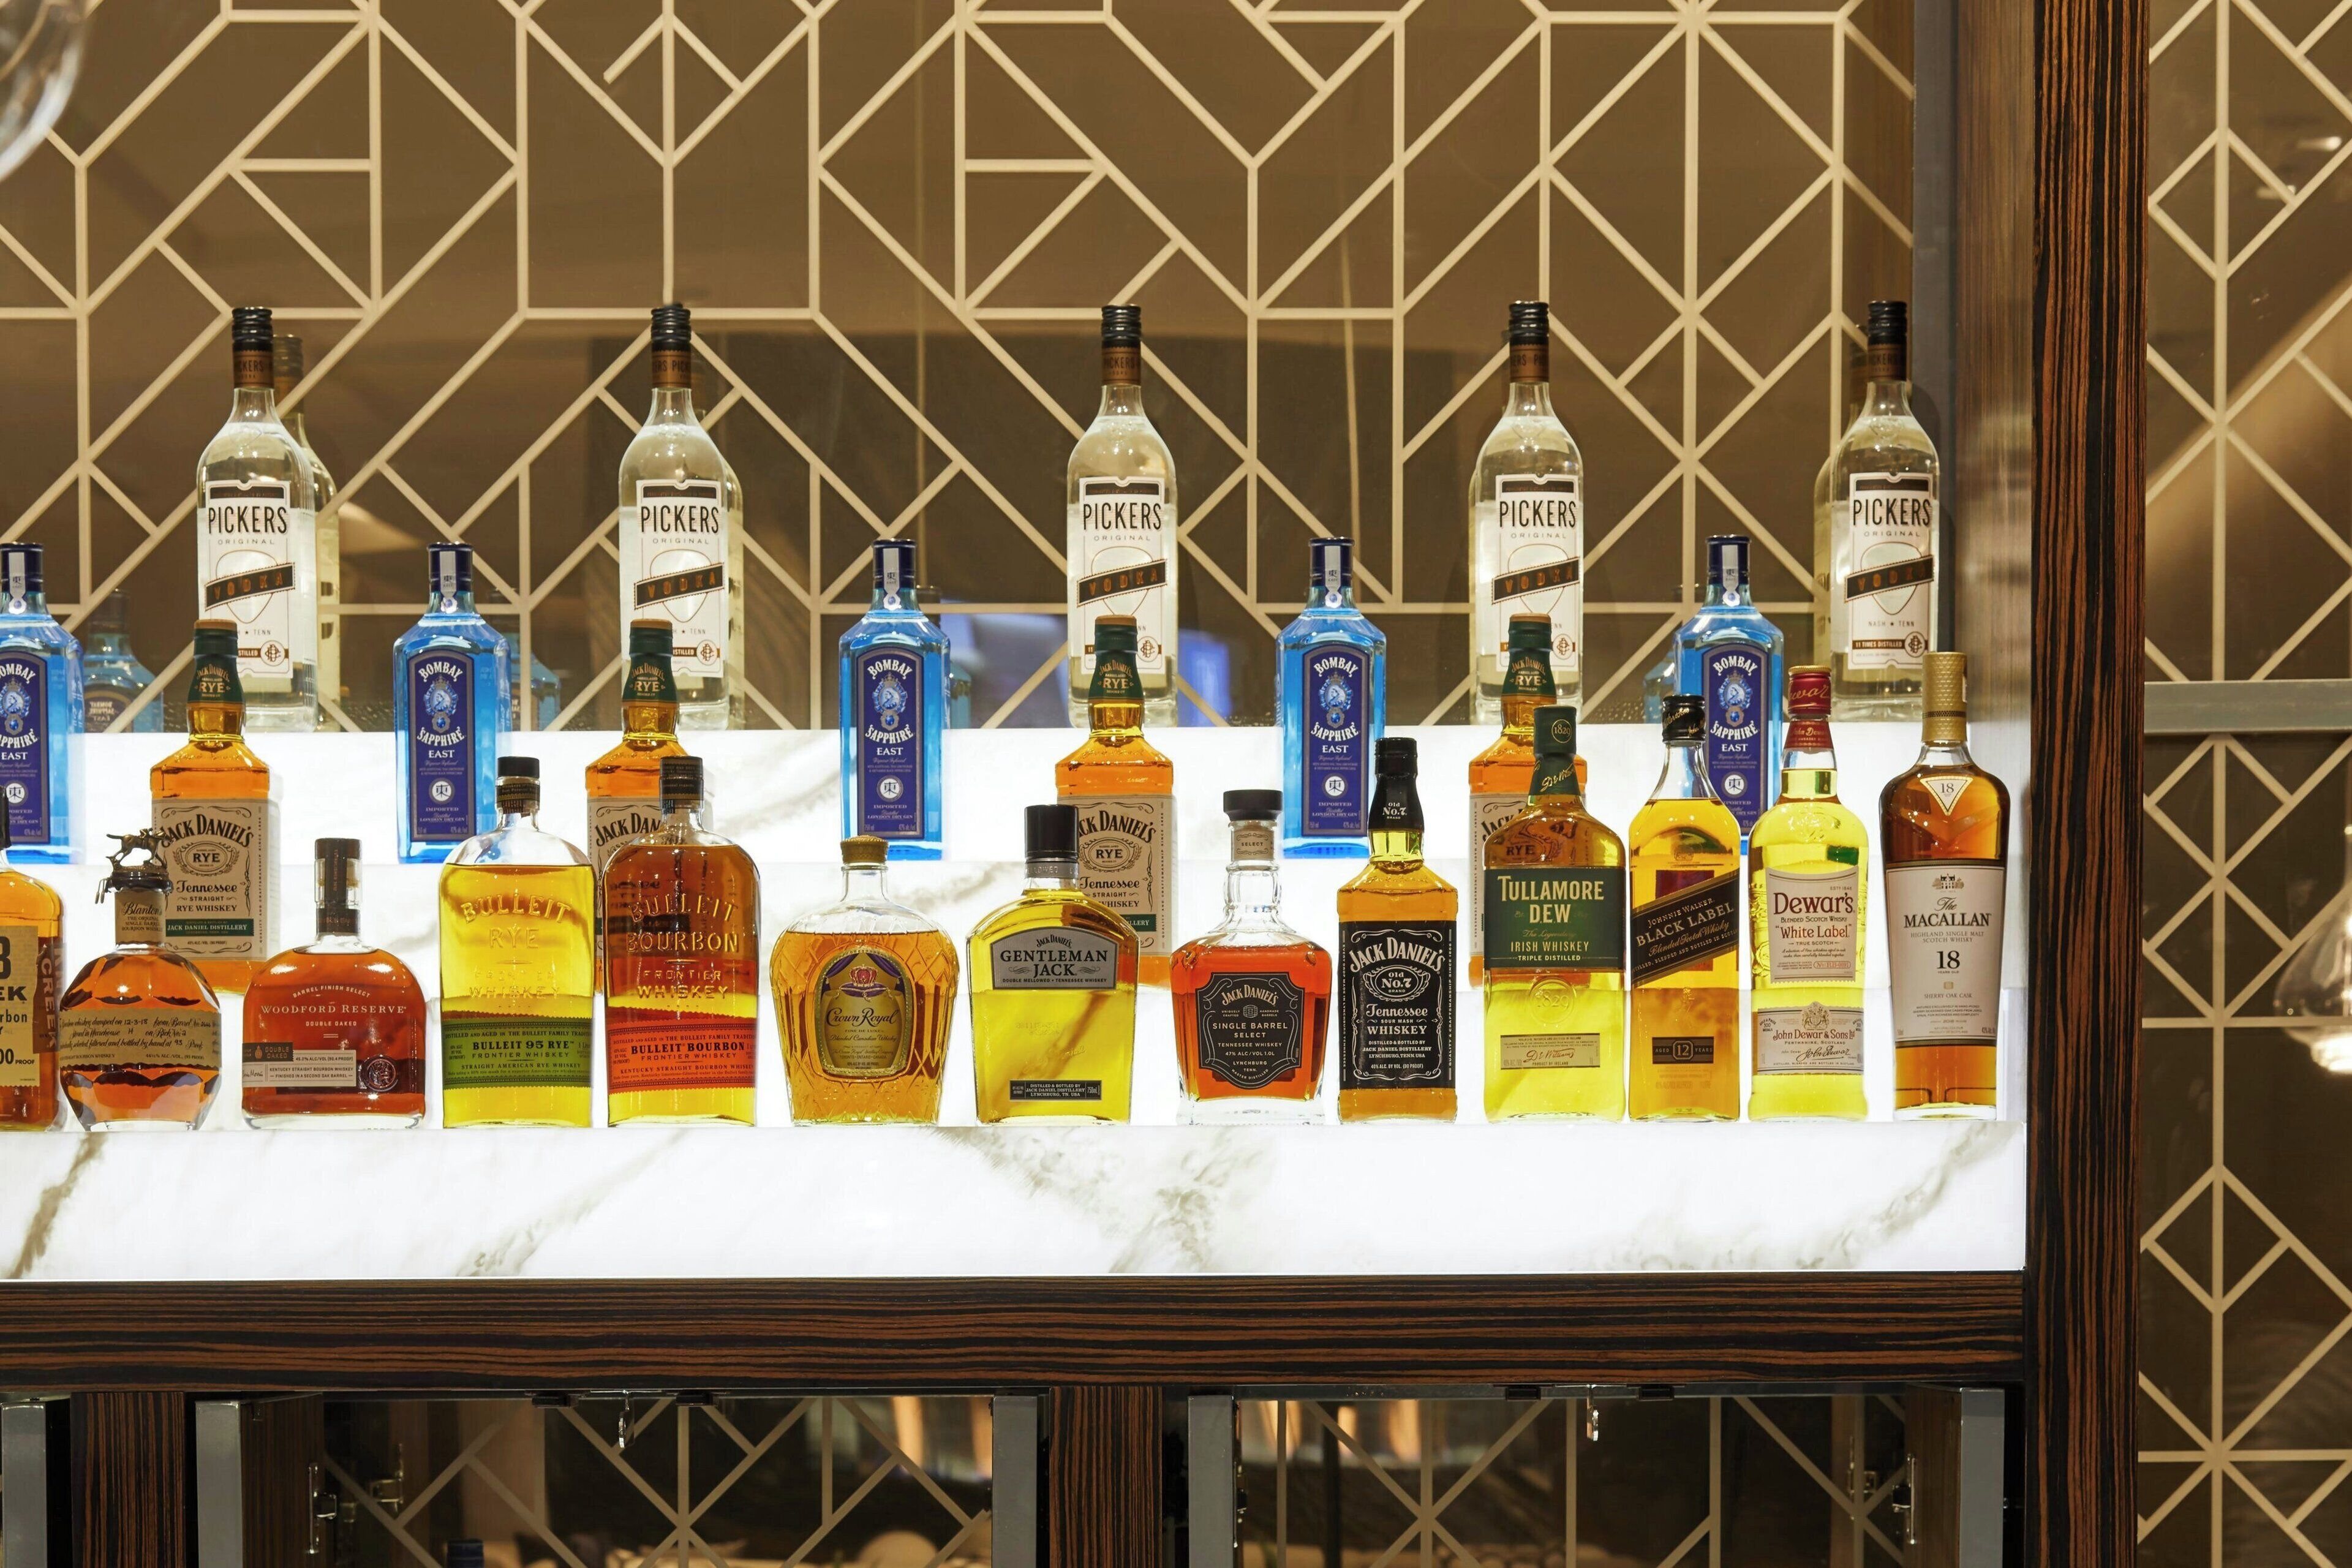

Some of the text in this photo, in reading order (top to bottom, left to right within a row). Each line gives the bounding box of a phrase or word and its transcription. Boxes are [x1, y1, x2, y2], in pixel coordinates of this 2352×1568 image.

[209, 506, 287, 534] PICKERS
[641, 505, 719, 533] PICKERS
[1084, 503, 1161, 530] PICKERS
[1500, 500, 1576, 527] PICKERS
[1853, 498, 1931, 527] PICKERS
[214, 573, 284, 600] VODKA
[647, 571, 715, 598] VODKA
[1089, 568, 1158, 597] VODKA
[1505, 568, 1573, 594] VODKA
[0, 663, 36, 684] OMBAY
[418, 662, 463, 682] BOMBAY
[867, 659, 913, 679] BOMBAY
[1314, 657, 1359, 677] BOMBAY
[1713, 655, 1757, 676] BOMBAY
[199, 681, 225, 692] RYE
[635, 681, 660, 692] RYE
[1102, 678, 1128, 688] RYE
[1515, 675, 1542, 686] RYE
[0, 729, 38, 748] PPHIRE
[417, 726, 465, 747] SAPPHIRE
[865, 724, 914, 744] SAPPHIRE
[1311, 722, 1359, 742] SAPPHIRE
[1554, 724, 1570, 736] 1829
[1710, 720, 1758, 741] SAPPHIRE
[1940, 783, 1954, 793] 18
[196, 814, 254, 848] DANIEL'S
[595, 816, 627, 847] JACK
[1099, 810, 1156, 843] DANIEL'S
[193, 853, 221, 862] RYE
[1096, 850, 1123, 858] RYE
[1506, 845, 1535, 857] RYE
[176, 880, 237, 892] Tennessee
[1080, 876, 1140, 889] Tennessee
[1498, 876, 1604, 901] TULLAMORE
[461, 893, 571, 924] BULLEIT
[629, 894, 737, 922] BULLEIT
[1648, 898, 1713, 928] JOHNNIE WALKER
[1774, 892, 1853, 914] Dewar's
[1934, 897, 1957, 911] The
[1637, 902, 1734, 947] BLACK LABEL
[1904, 913, 1989, 928] MACALLAN
[490, 927, 539, 949] RYE
[627, 932, 739, 952] BOURBON
[1036, 934, 1072, 948] JACK DANIEL'S
[1511, 941, 1589, 952] IRISH WHISKEY
[1000, 950, 1108, 962] GENTLEMAN
[1349, 937, 1445, 973] JACK DANIEL'S
[1937, 951, 1960, 969] 18
[1033, 964, 1075, 978] JACK
[293, 987, 319, 998] BARREL
[346, 986, 371, 998] SELECT
[637, 986, 728, 999] WHISKEY
[1381, 979, 1412, 989] No.7
[40, 958, 58, 1049] CREEK
[1221, 984, 1279, 1006] JACK DANIEL'S
[260, 1005, 404, 1014] WOODFORD RESERVE
[827, 1008, 899, 1027] Crown Royal
[1366, 1004, 1428, 1016] Tennessee
[1367, 1026, 1427, 1035] WHISKEY
[1773, 1030, 1849, 1041] John Dewar & Sons
[473, 1040, 569, 1050] BULLEIT 95 RYE
[631, 1042, 745, 1054] BULLEIT BOURBON
[1676, 1044, 1689, 1056] 12
